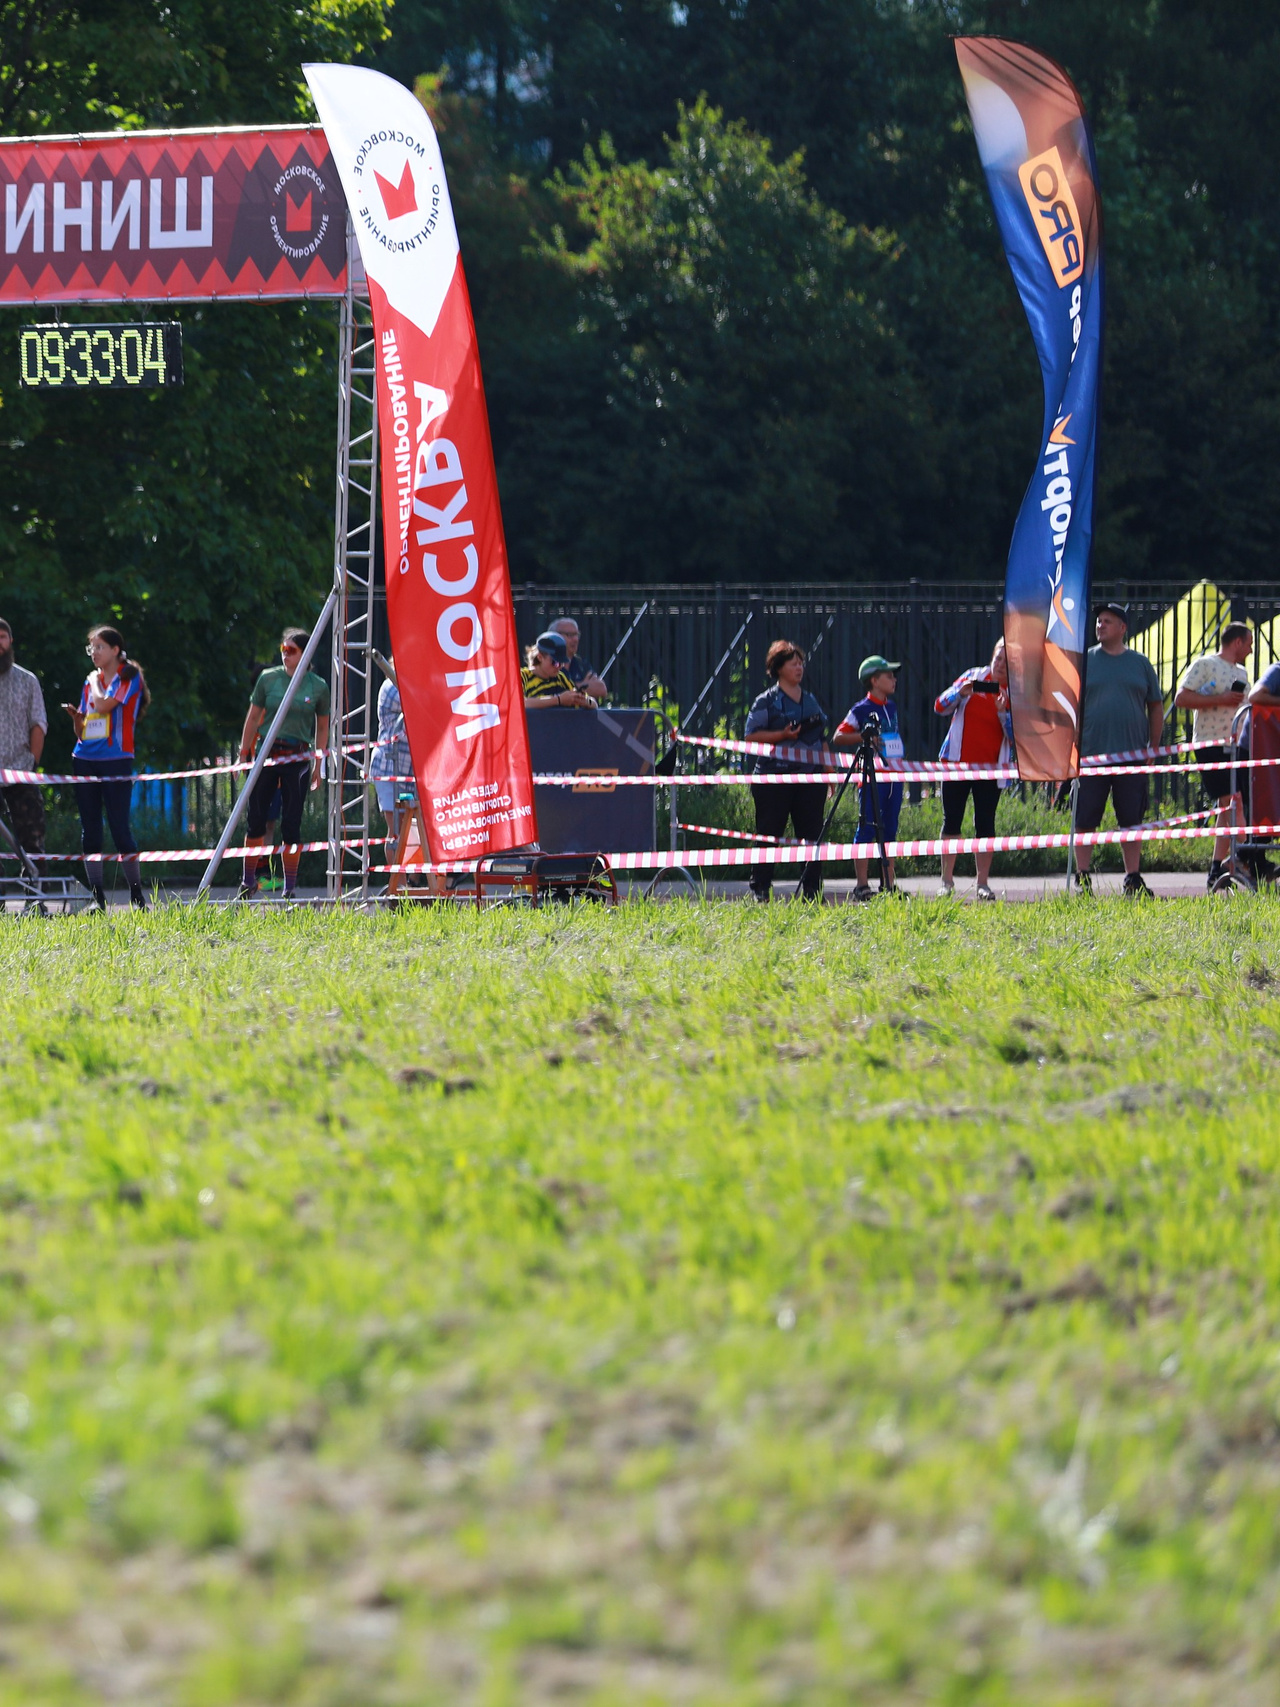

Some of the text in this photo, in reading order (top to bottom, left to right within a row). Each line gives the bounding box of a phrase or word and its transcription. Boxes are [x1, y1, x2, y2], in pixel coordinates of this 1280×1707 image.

[274, 165, 326, 195] МОСКОВСКОЕ
[270, 214, 329, 259] ОРИЕНТИРОВАНИЕ
[21, 329, 167, 386] 09:33:04
